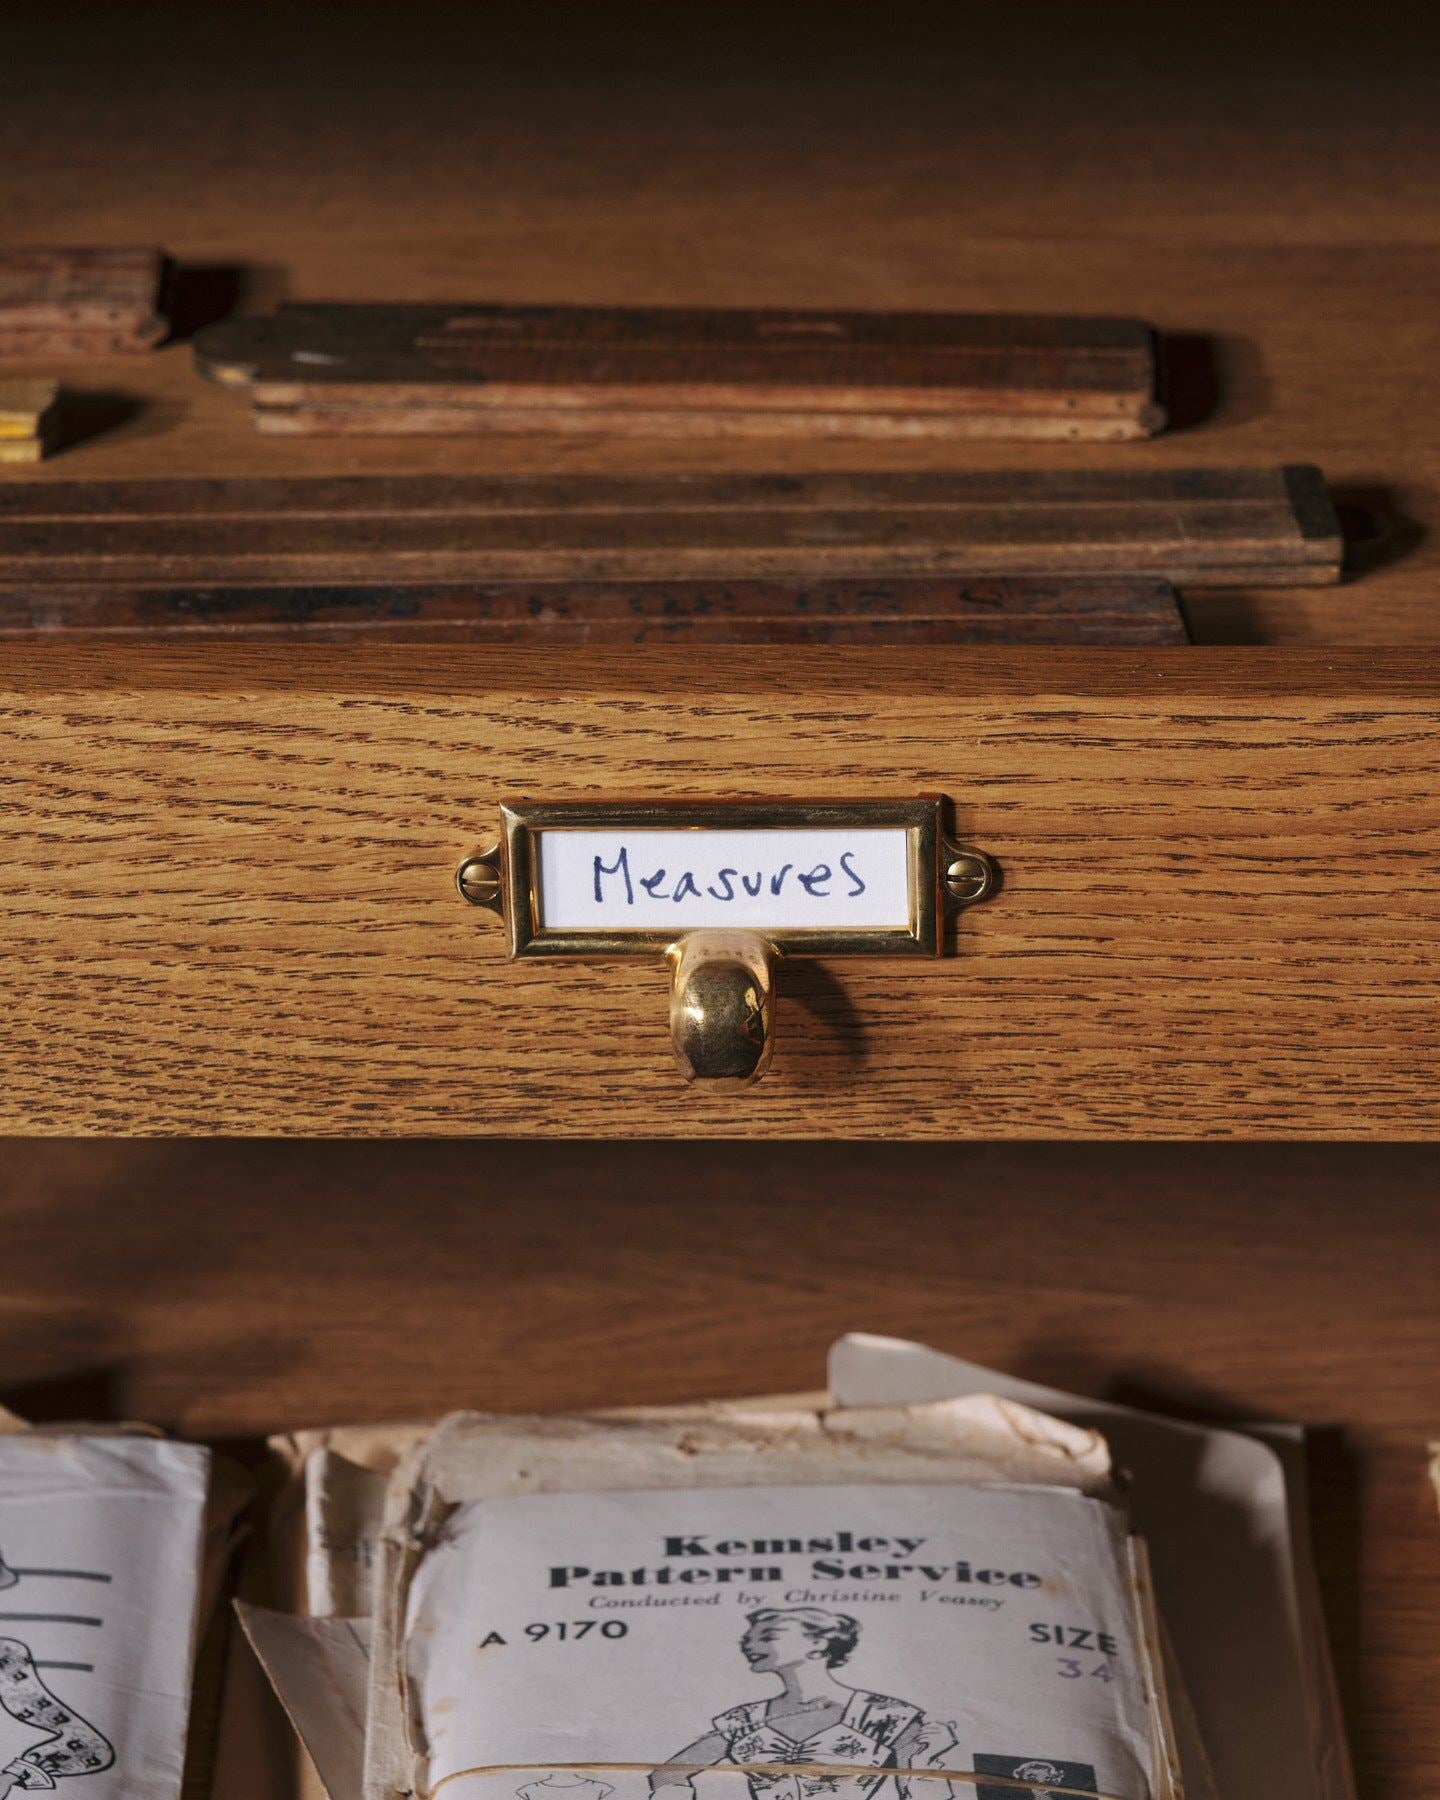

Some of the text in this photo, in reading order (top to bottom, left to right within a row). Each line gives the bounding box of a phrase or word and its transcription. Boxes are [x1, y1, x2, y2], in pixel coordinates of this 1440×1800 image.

[593, 846, 866, 905] Measures
[664, 1532, 927, 1558] Kemsley
[549, 1558, 1043, 1590] Pattern Service
[588, 1589, 1005, 1612] Conducted by Christine Veasey
[479, 1620, 629, 1649] A 9170
[1029, 1623, 1118, 1656] SIZE
[1057, 1658, 1114, 1684] 34
